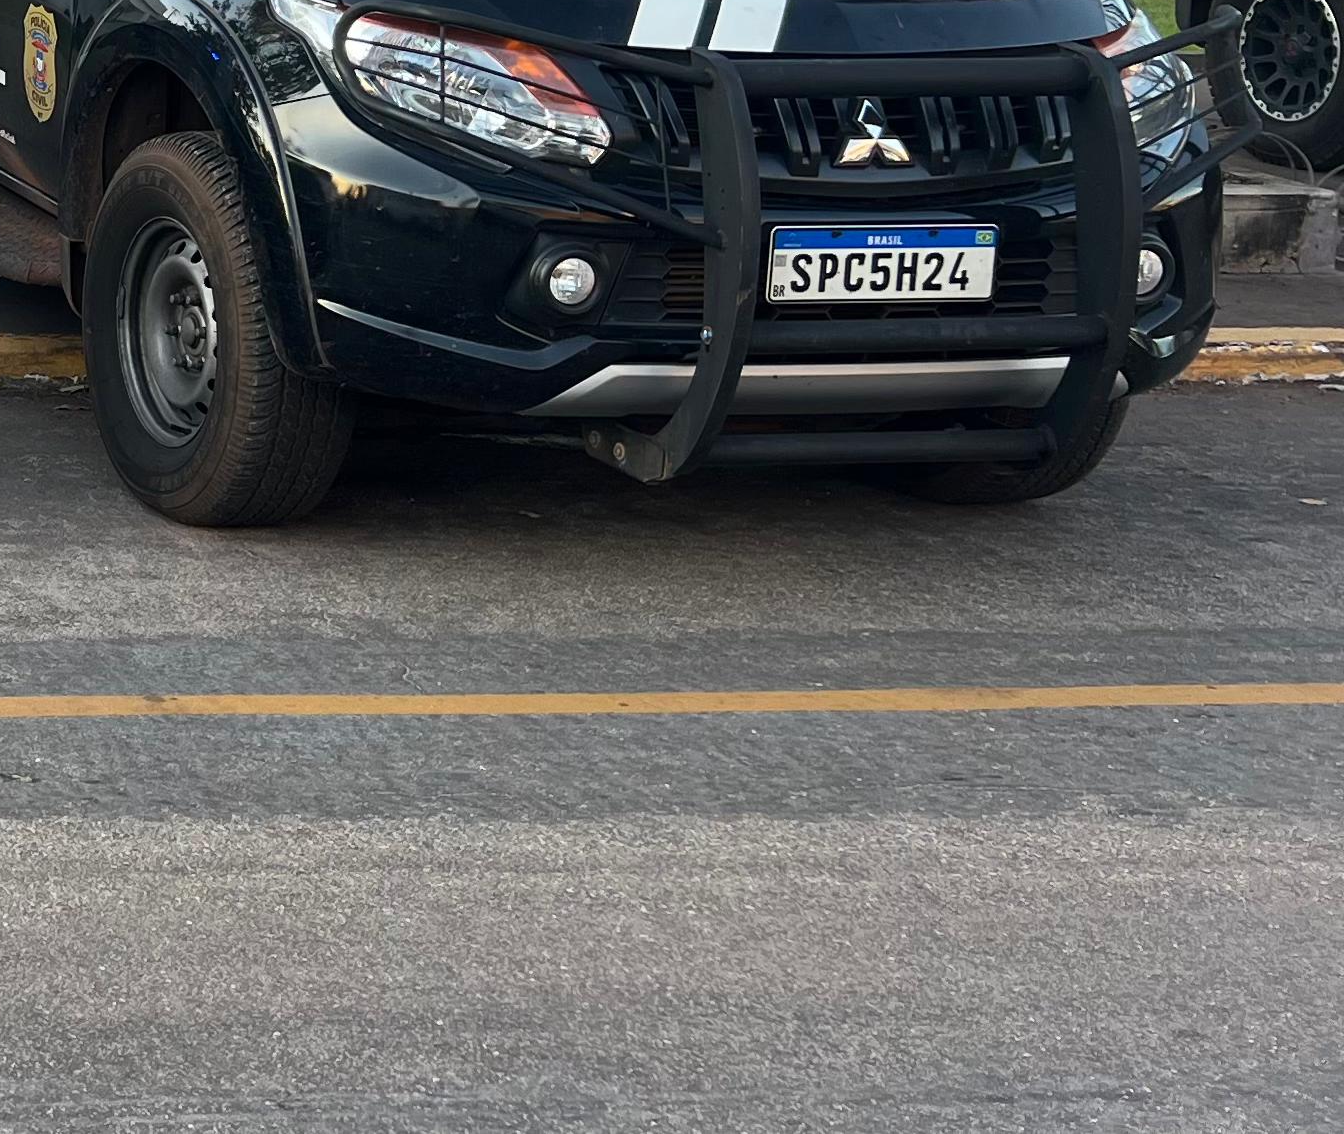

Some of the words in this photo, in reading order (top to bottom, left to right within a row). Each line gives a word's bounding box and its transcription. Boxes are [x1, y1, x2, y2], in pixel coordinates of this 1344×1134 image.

[867, 235, 903, 246] BRASIL
[790, 251, 970, 293] SPC5H24
[773, 284, 785, 297] BR
